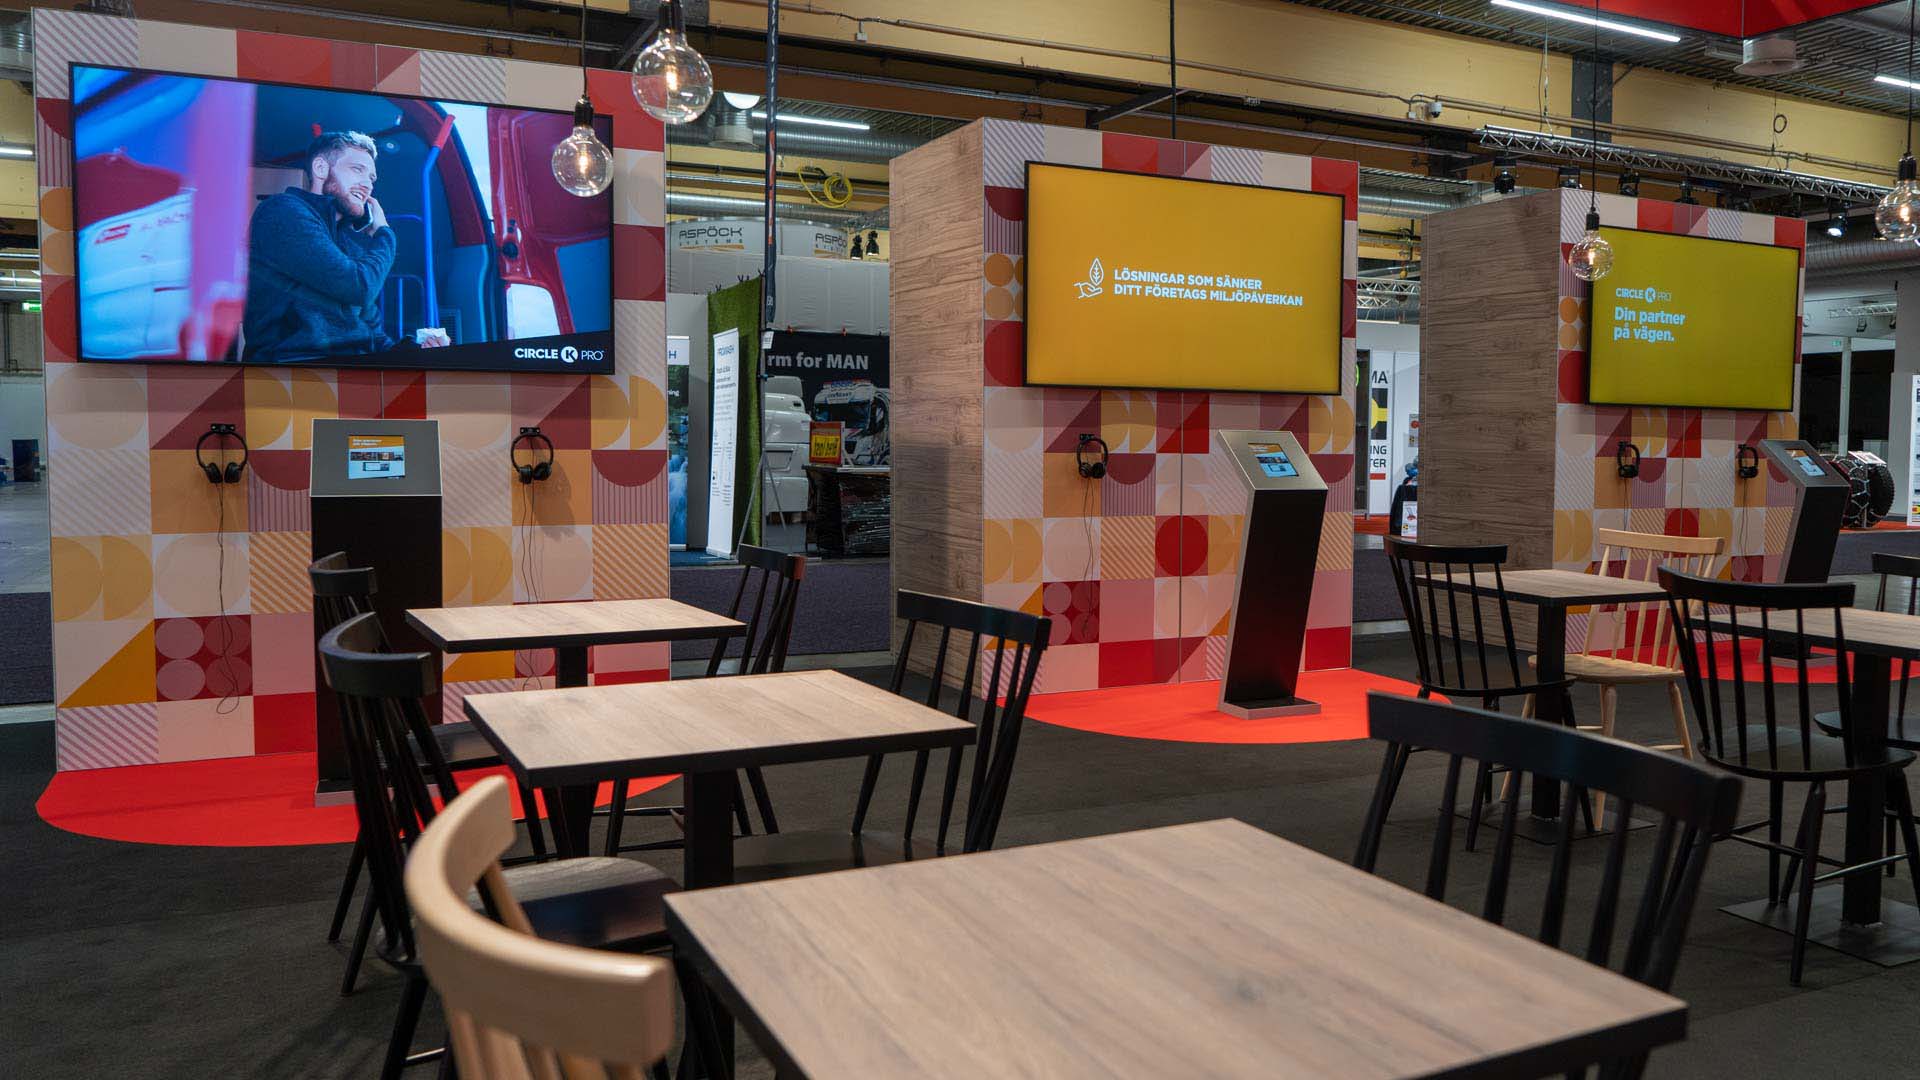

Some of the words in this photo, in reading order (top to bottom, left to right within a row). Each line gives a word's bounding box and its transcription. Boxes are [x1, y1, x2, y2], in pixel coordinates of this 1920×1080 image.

[679, 225, 743, 240] ASPÖCK
[1114, 267, 1185, 285] LÖSNINGAR
[1187, 274, 1214, 287] SOM
[1216, 274, 1263, 290] SÄNKER
[1114, 283, 1142, 296] DITT
[1145, 284, 1207, 300] FÖRETAGS
[1210, 290, 1304, 306] MILJÖPÅVERKAN
[1615, 287, 1644, 300] CIRCLE
[1614, 306, 1637, 321] Din
[1639, 310, 1686, 326] partner
[1614, 322, 1631, 341] på
[1633, 325, 1675, 344] vägen.
[514, 348, 559, 359] CIRCLE
[560, 346, 579, 363] K
[581, 350, 604, 360] PRO
[796, 351, 823, 369] for
[826, 354, 869, 370] MAN
